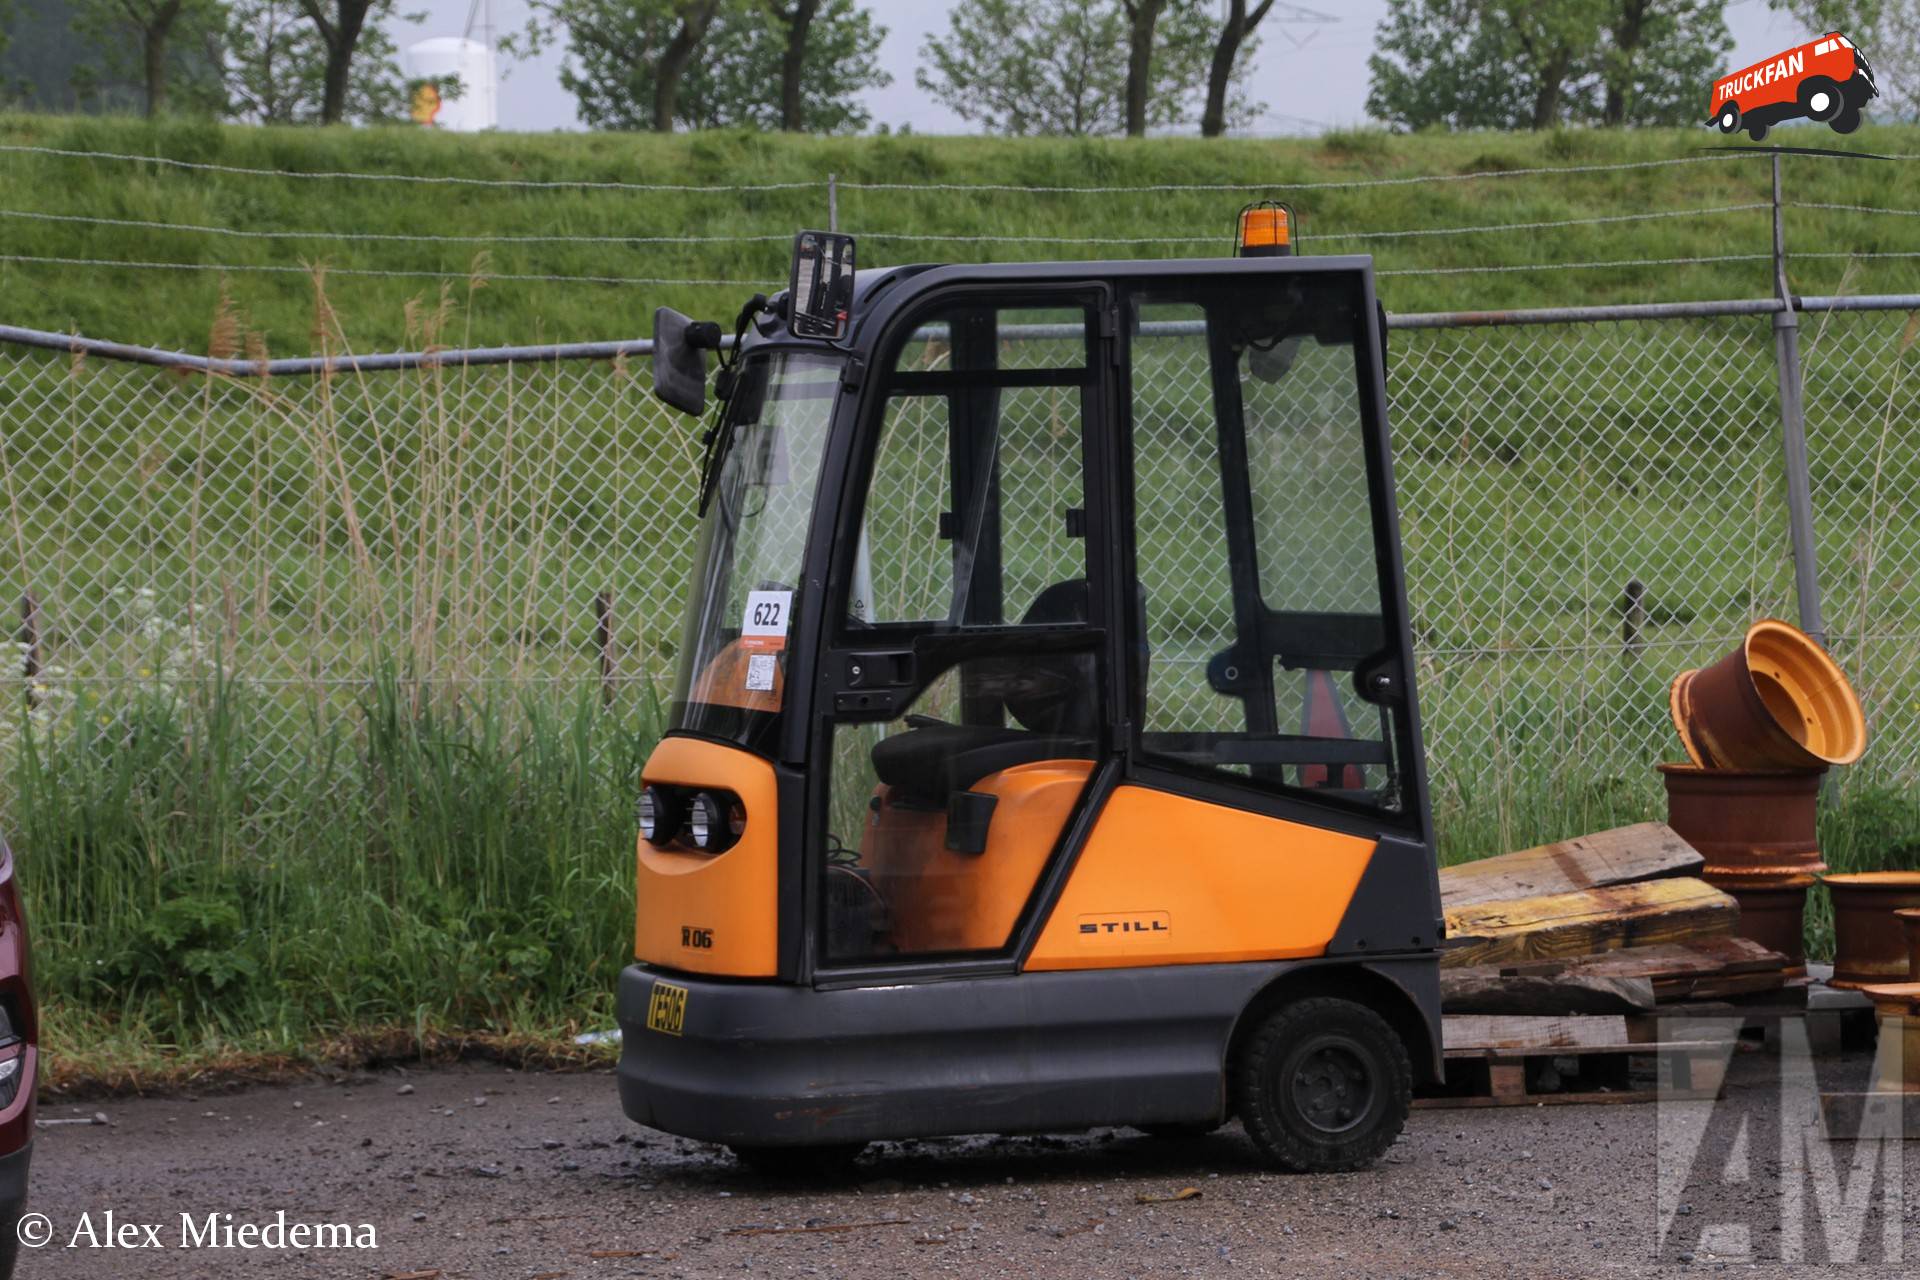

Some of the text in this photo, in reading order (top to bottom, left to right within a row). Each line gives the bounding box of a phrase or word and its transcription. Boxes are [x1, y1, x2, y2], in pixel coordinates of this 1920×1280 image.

[754, 603, 780, 626] 622
[682, 927, 714, 949] R 06
[1080, 921, 1168, 933] STILL
